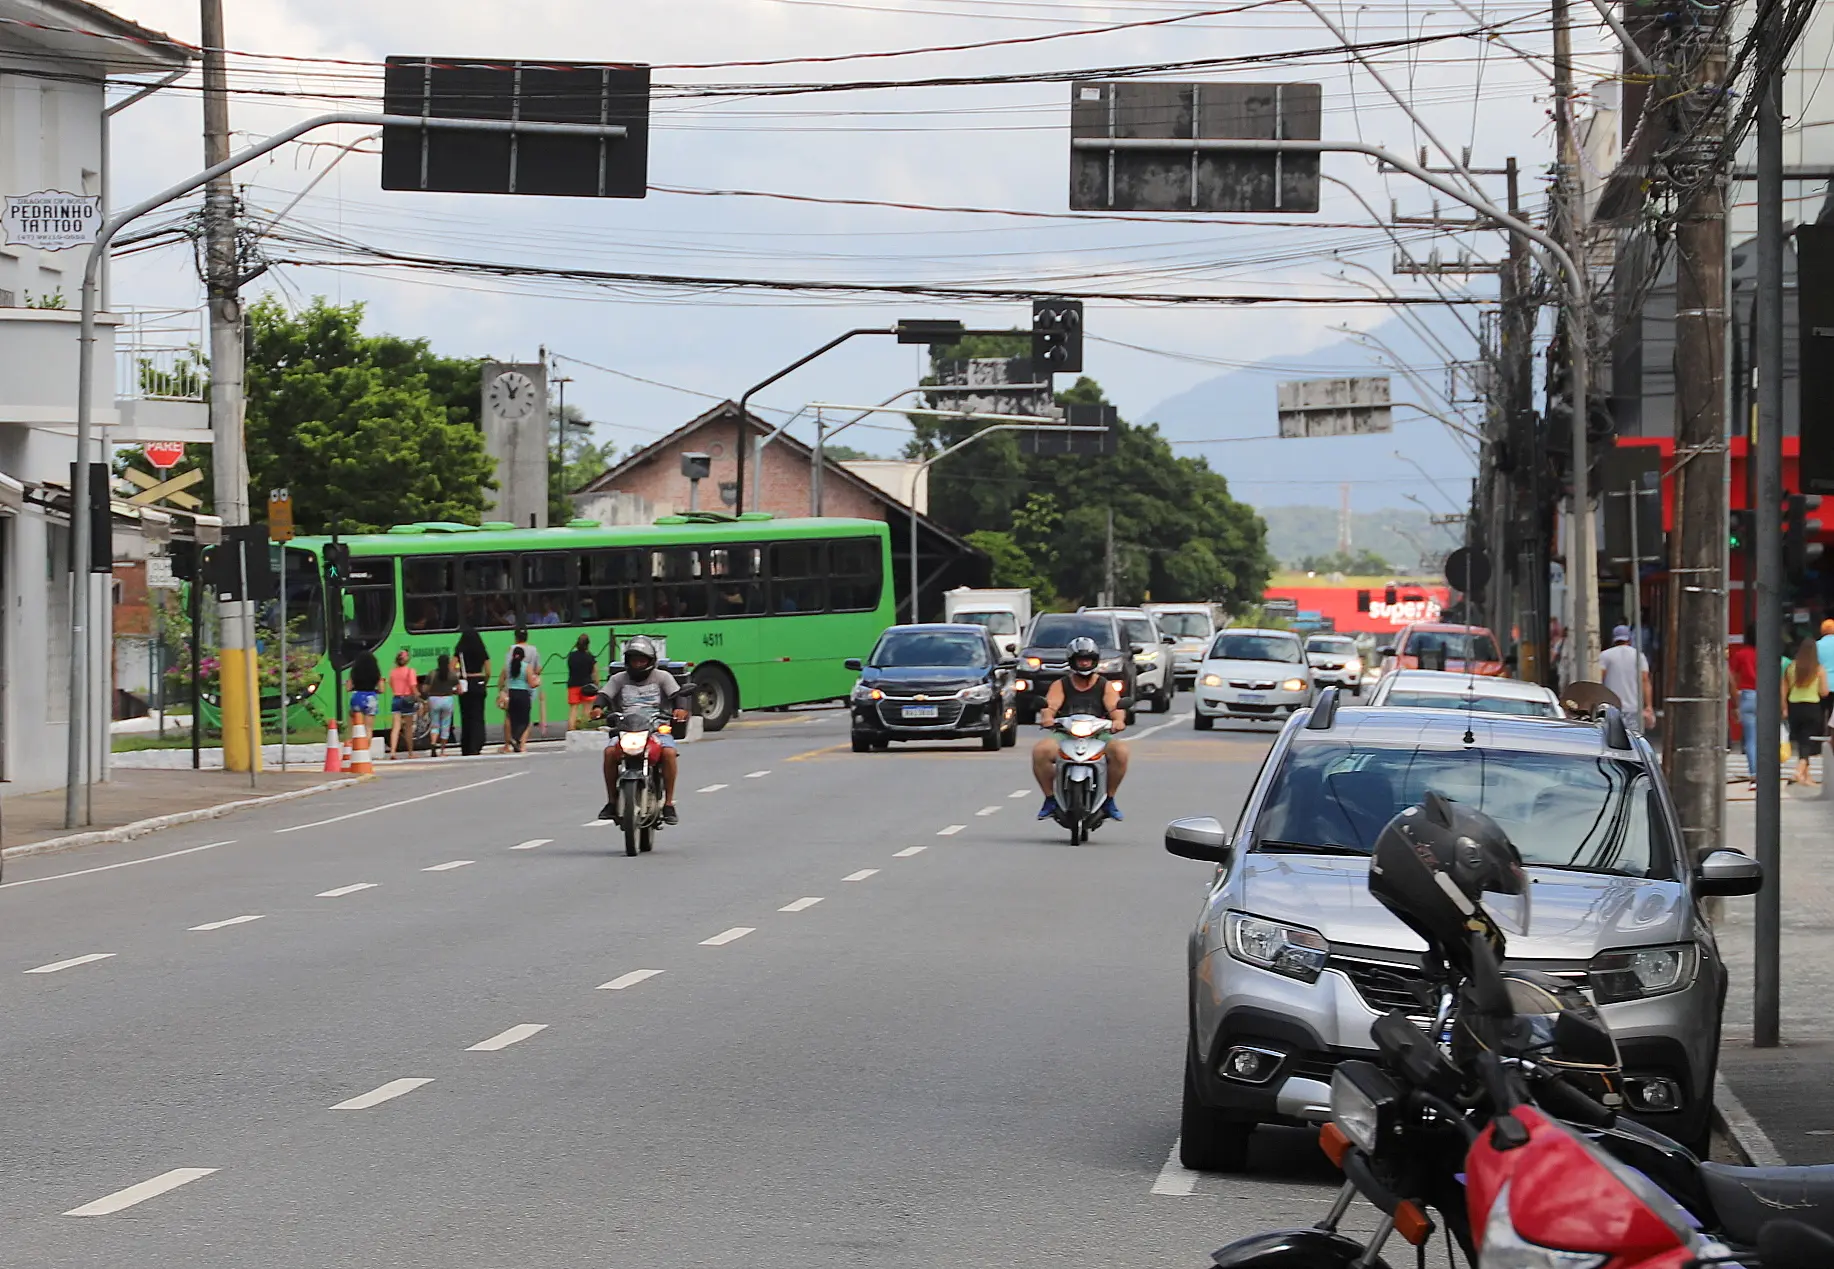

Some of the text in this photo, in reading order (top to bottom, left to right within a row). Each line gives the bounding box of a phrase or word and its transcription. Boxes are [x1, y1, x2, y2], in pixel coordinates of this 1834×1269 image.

[11, 205, 92, 219] PEDRINHO
[20, 219, 82, 233] TATTOO
[148, 441, 181, 451] PARE
[703, 633, 723, 647] 4511
